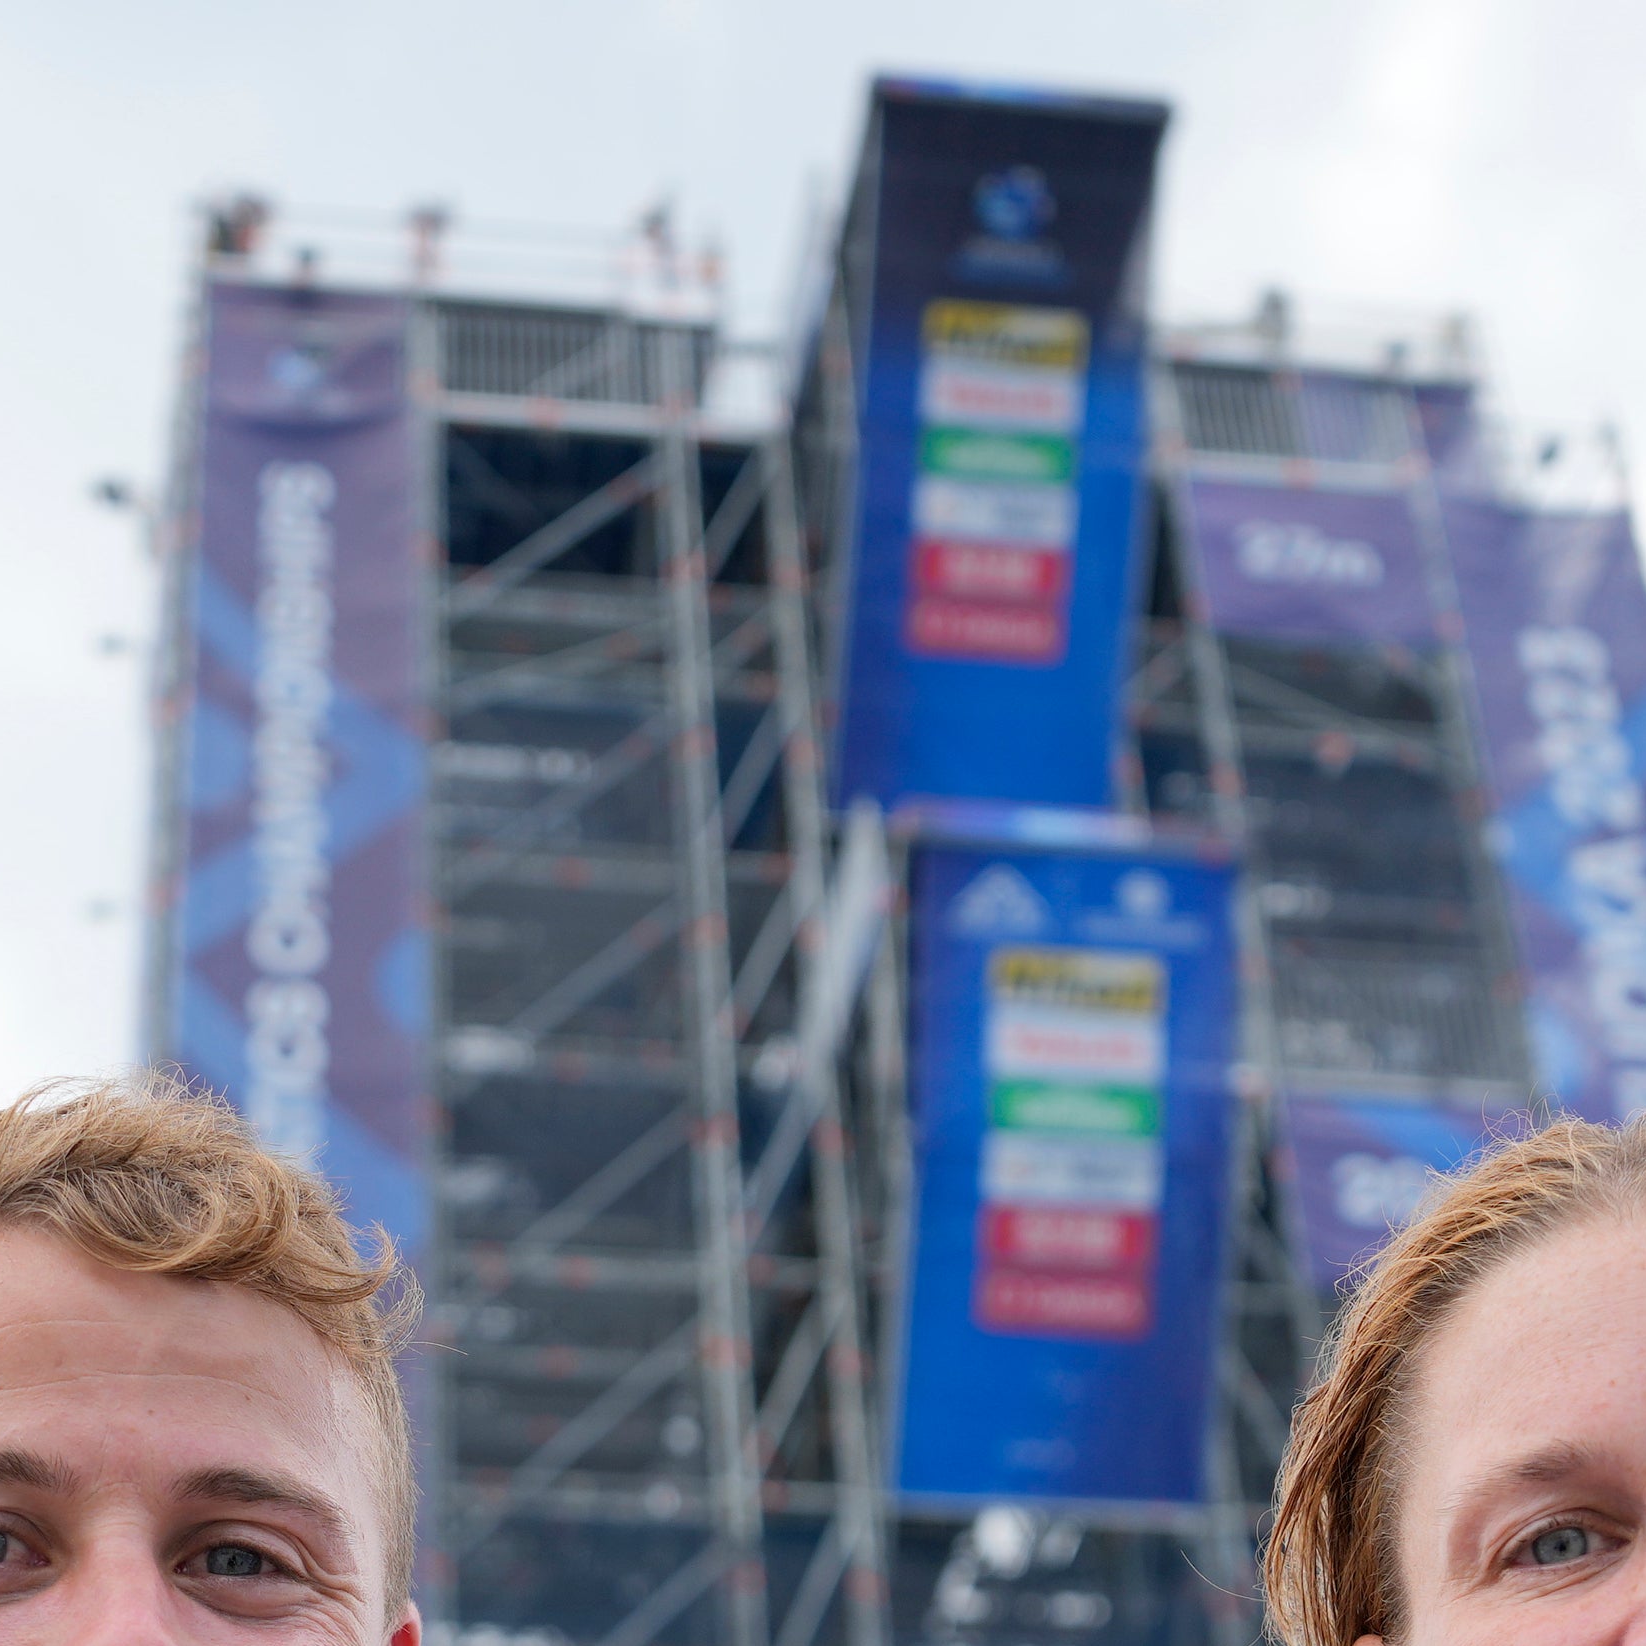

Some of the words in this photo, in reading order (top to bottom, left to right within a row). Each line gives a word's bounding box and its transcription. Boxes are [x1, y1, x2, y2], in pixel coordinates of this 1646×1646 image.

[249, 462, 335, 973] CHAMPIONSHIPS
[1519, 628, 1646, 834] 2023
[247, 976, 329, 1168] TICS
